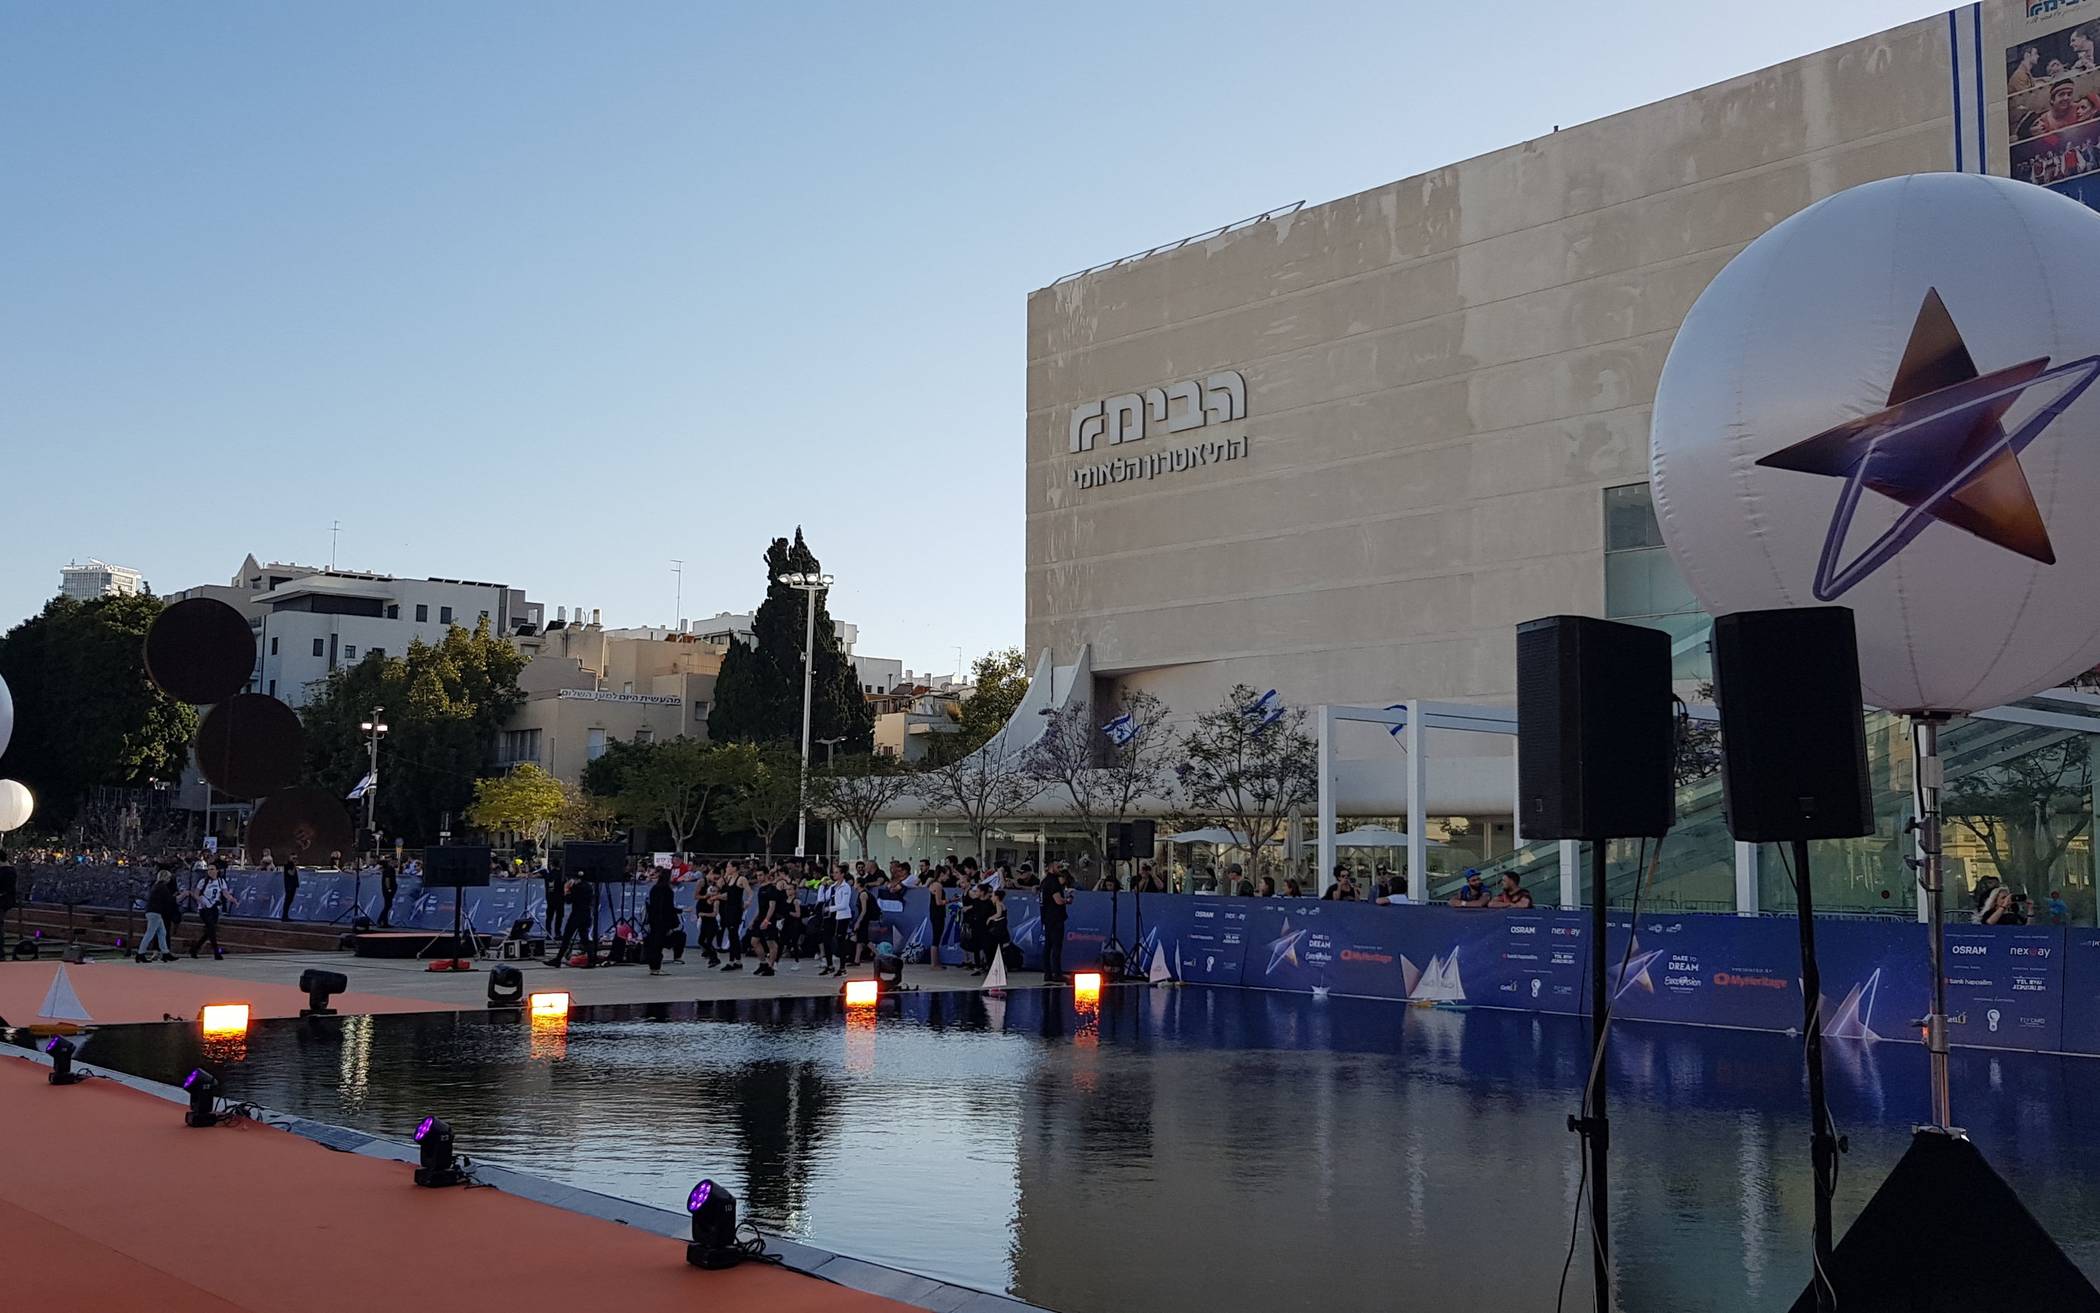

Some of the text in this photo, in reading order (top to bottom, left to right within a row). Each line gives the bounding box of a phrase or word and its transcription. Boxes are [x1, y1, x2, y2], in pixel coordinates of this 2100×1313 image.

[1070, 370, 1247, 454] הבימה
[1073, 436, 1248, 489] התיאטרון הלאומי
[1510, 926, 1536, 935] OSRAM
[1952, 945, 1987, 955] OSRAM
[1672, 954, 1689, 962] DARE
[1668, 961, 1700, 972] DREAM
